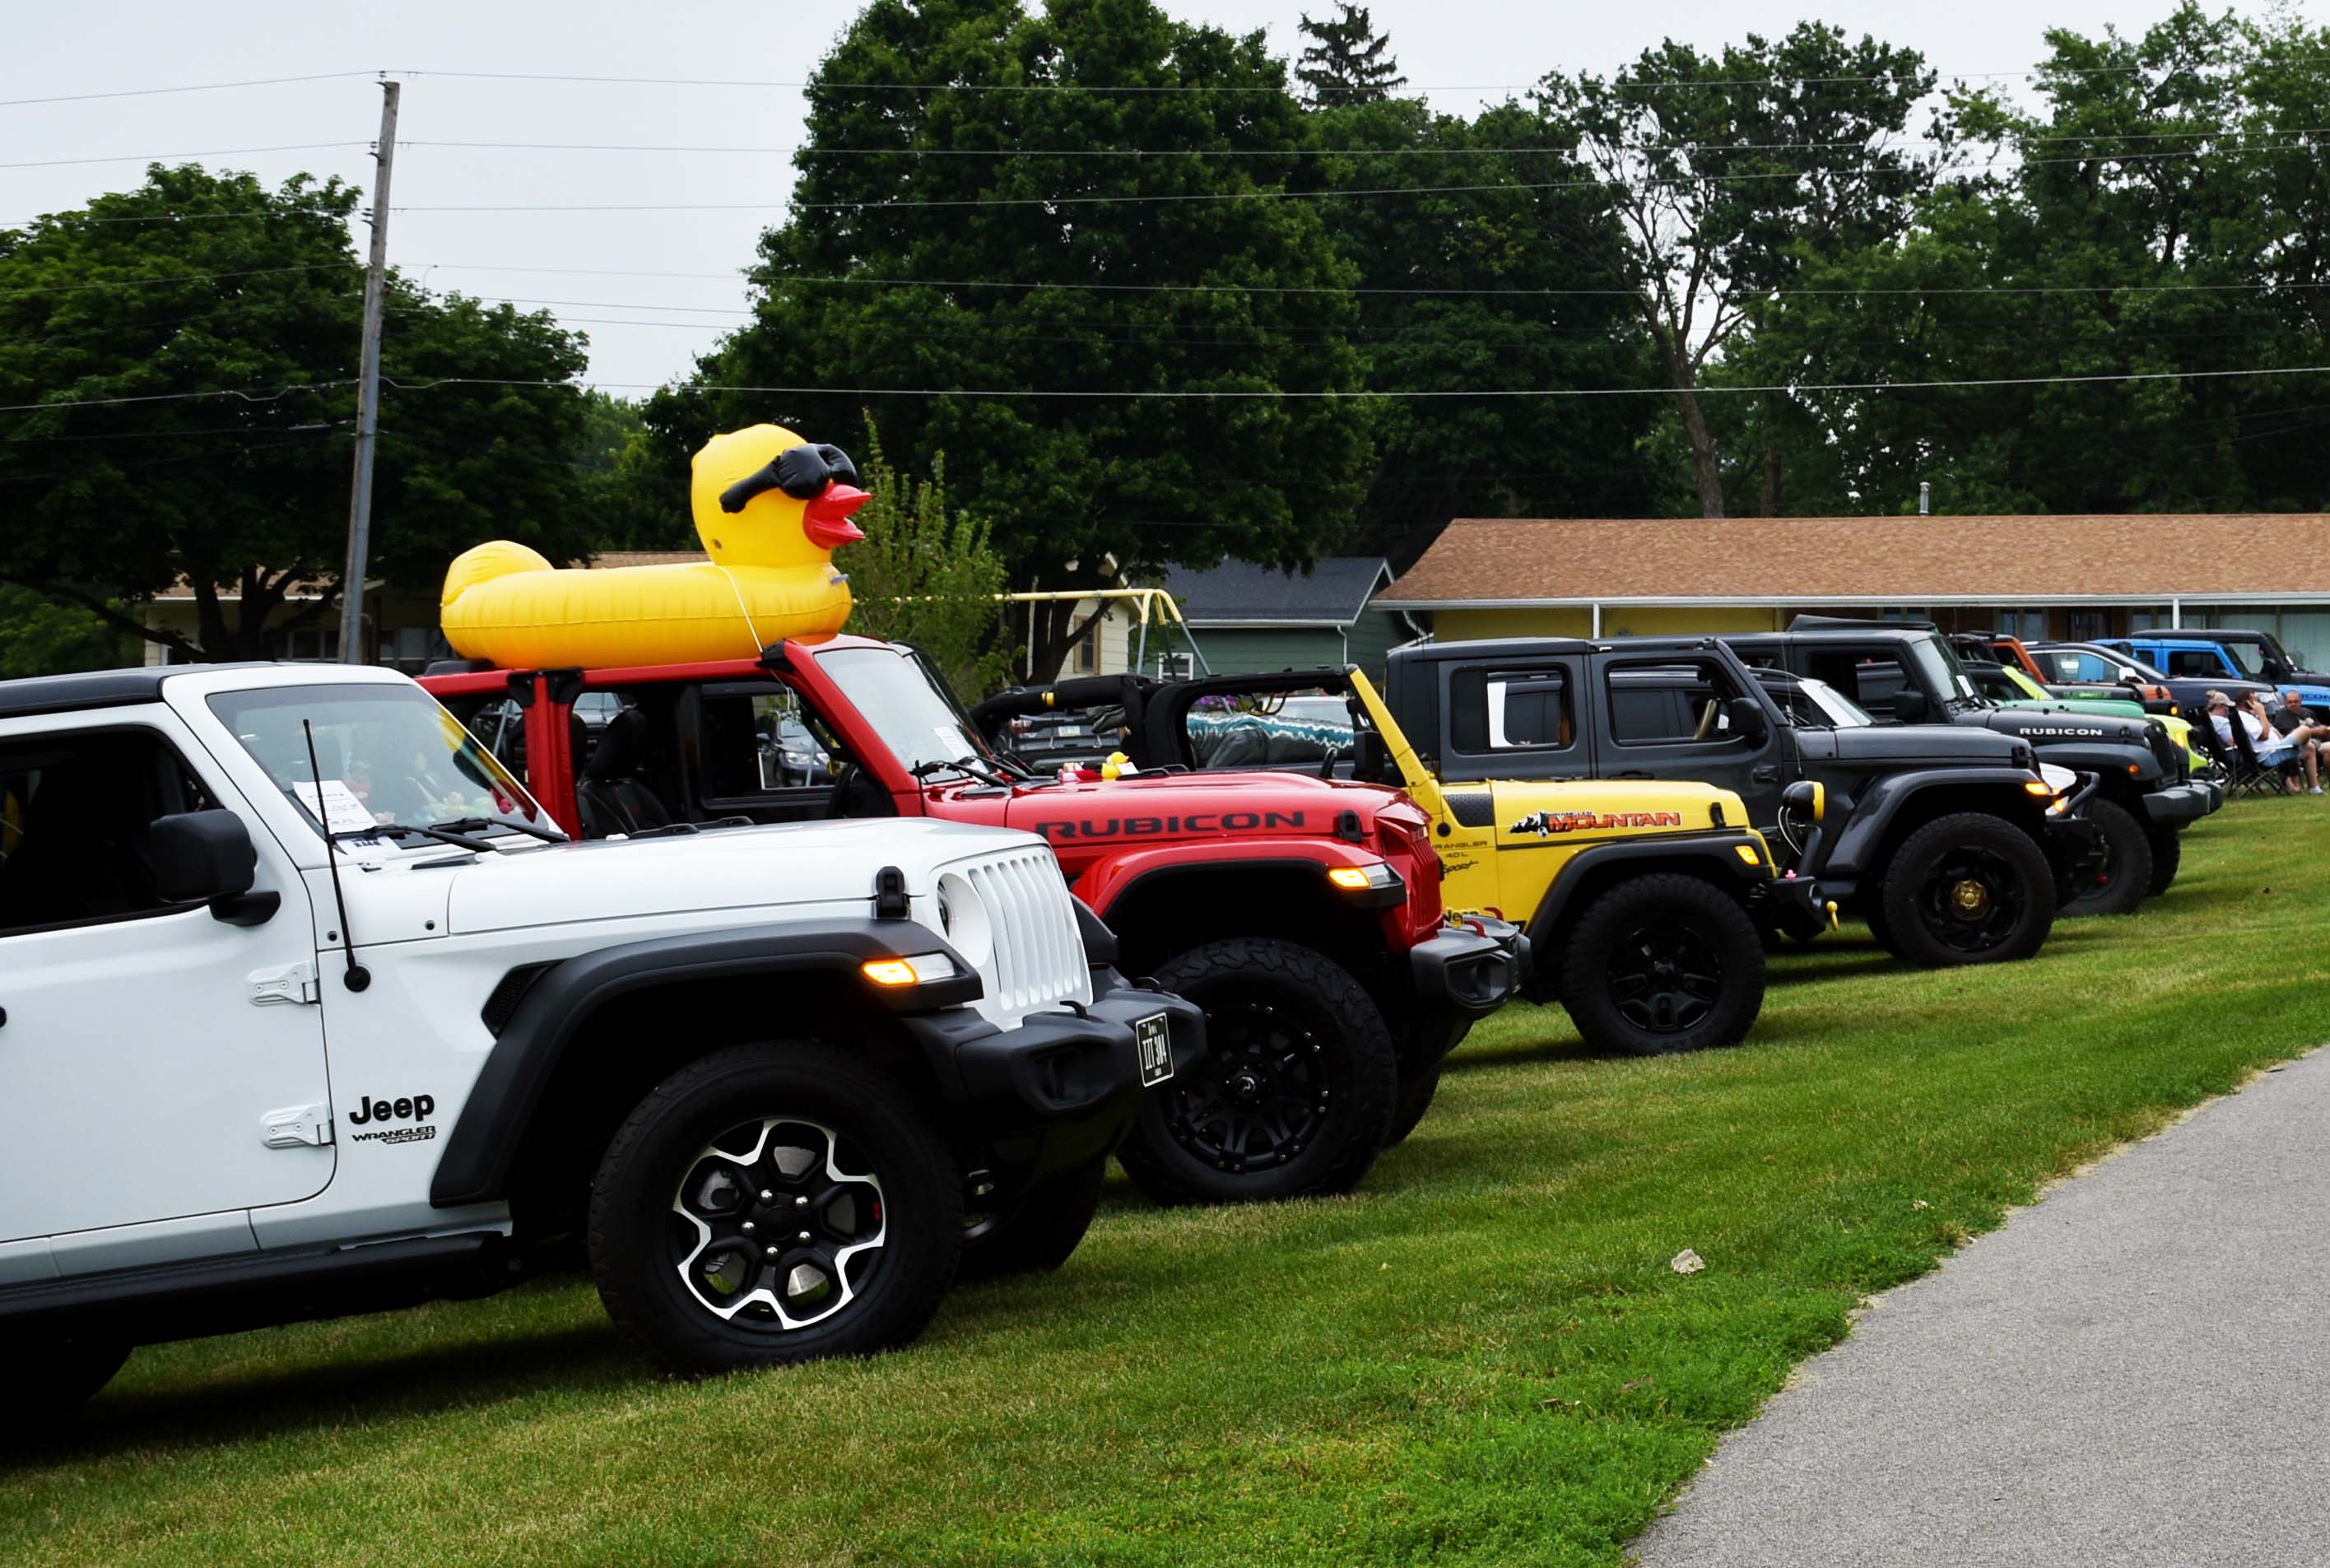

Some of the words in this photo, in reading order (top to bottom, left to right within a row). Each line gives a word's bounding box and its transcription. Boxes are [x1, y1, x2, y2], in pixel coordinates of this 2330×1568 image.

[2020, 728, 2103, 736] RUBICON
[1035, 811, 1305, 840] RUBICON
[1548, 812, 1681, 832] MOUNTAIN
[1434, 841, 1487, 849] RANGLER
[349, 1095, 435, 1124] Jeep
[351, 1125, 436, 1142] WRANGLER
[384, 1133, 435, 1144] SPORT
